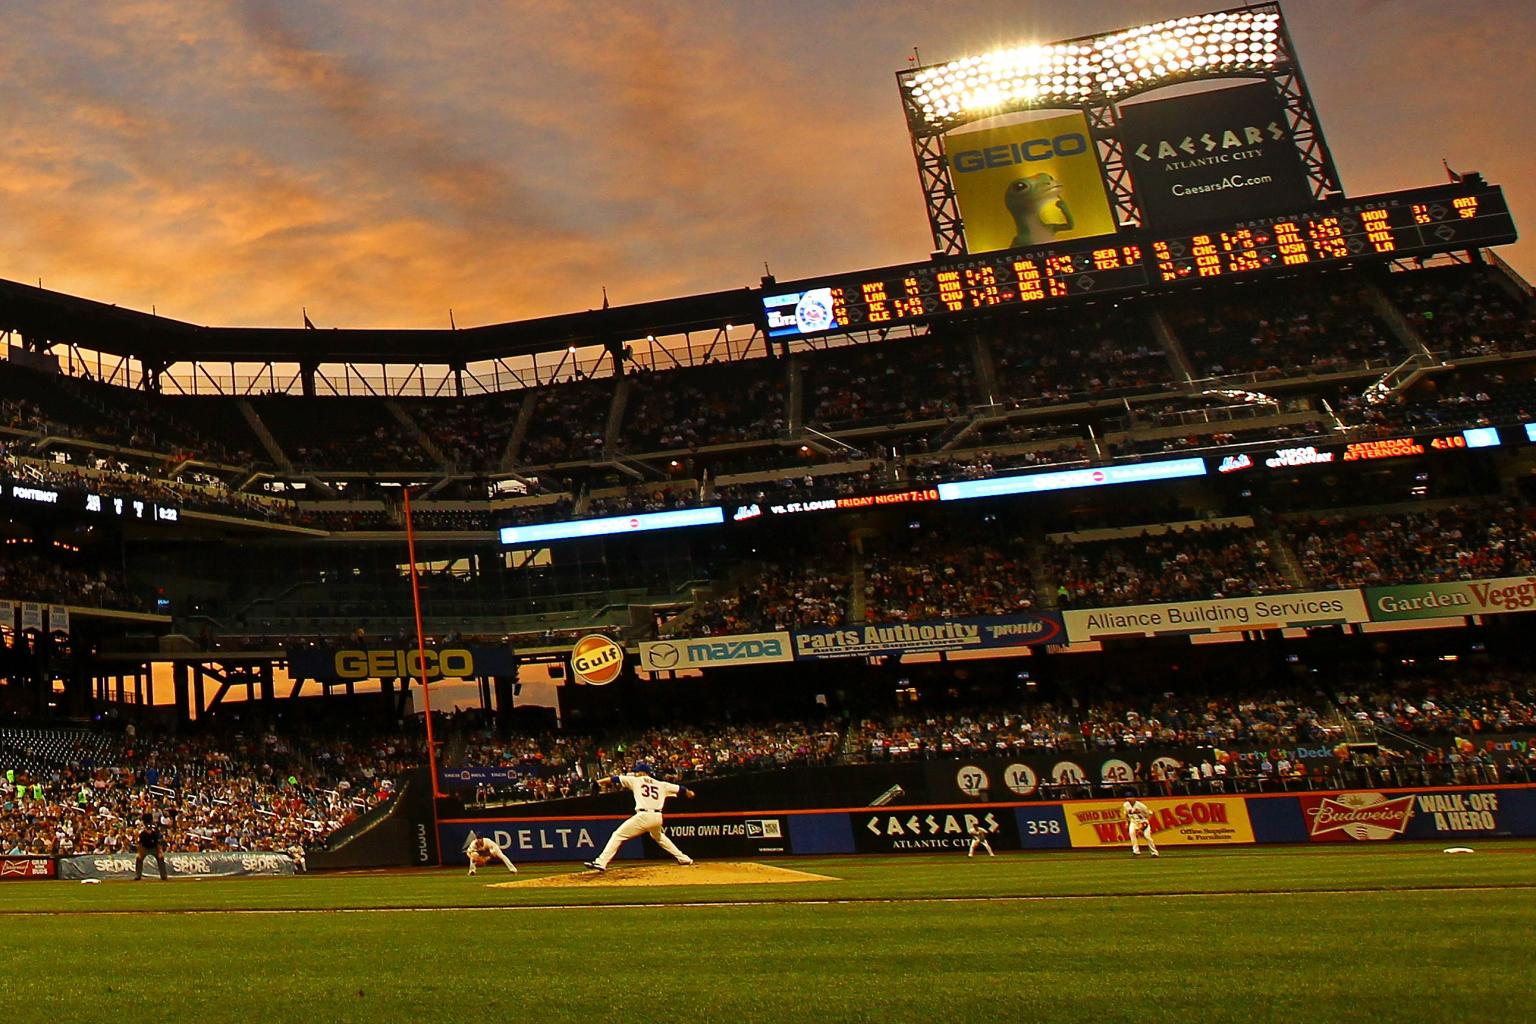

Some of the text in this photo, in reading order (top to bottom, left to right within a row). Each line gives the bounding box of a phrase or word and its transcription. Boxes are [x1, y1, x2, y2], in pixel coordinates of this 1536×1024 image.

[1135, 122, 1287, 162] CAESARS
[952, 132, 1088, 174] GEICO
[1165, 149, 1264, 171] ATLANTIC CITY
[1172, 173, 1273, 197] CaesarsAC.com
[1453, 196, 1479, 208] ARI
[1361, 209, 1388, 221] HOU
[1458, 208, 1476, 219] SF
[1273, 222, 1300, 234] STL
[1365, 221, 1392, 232] COL
[1192, 235, 1210, 246] SD
[1277, 233, 1303, 244] ATL
[1368, 231, 1394, 242] MIL
[1375, 241, 1395, 253] LA
[1092, 248, 1117, 260] SEA
[1283, 254, 1310, 265] MIA
[1014, 260, 1038, 271] BAL
[1094, 259, 1120, 270] TEX
[1196, 255, 1220, 266] CIN
[937, 272, 960, 282] OAK
[1017, 269, 1039, 280] TOR
[1199, 265, 1221, 277] PIT
[862, 282, 884, 293] NYY
[939, 282, 960, 292] MIN
[1019, 280, 1041, 290] DET
[1021, 290, 1044, 301] BOS
[869, 301, 885, 311] KC
[948, 301, 962, 312] TB
[868, 311, 890, 323] CLE
[1346, 437, 1414, 453] SATURDAY
[1430, 436, 1465, 449] 4:10
[1343, 445, 1424, 461] AFTERNOON
[786, 502, 803, 514] ST.
[803, 499, 837, 513] LOUIS
[837, 496, 875, 509] FRIDAY
[875, 492, 910, 505] NIGHT
[910, 489, 939, 502] 7:10
[1378, 591, 1471, 614] Garden
[1087, 599, 1344, 630] Alliance Building Services
[796, 622, 979, 649] Parts Authority
[335, 649, 474, 678] GEICO
[575, 647, 617, 672] Gulf
[1230, 749, 1267, 764] Party
[1297, 745, 1333, 759] Deck
[963, 772, 982, 789] 37
[1014, 769, 1030, 786] 14
[1107, 767, 1128, 782] 42
[641, 784, 659, 800] 35
[1076, 809, 1101, 822] WHO
[1307, 806, 1415, 824] Budweiser
[1435, 811, 1496, 831] A HERO
[670, 825, 695, 837] YOUR
[698, 824, 720, 837] OWN
[723, 823, 745, 836] FLAG
[867, 813, 999, 836] CAESARS
[1026, 820, 1061, 835] 358
[494, 828, 595, 850] DELTA
[893, 839, 949, 849] ATLANTIC
